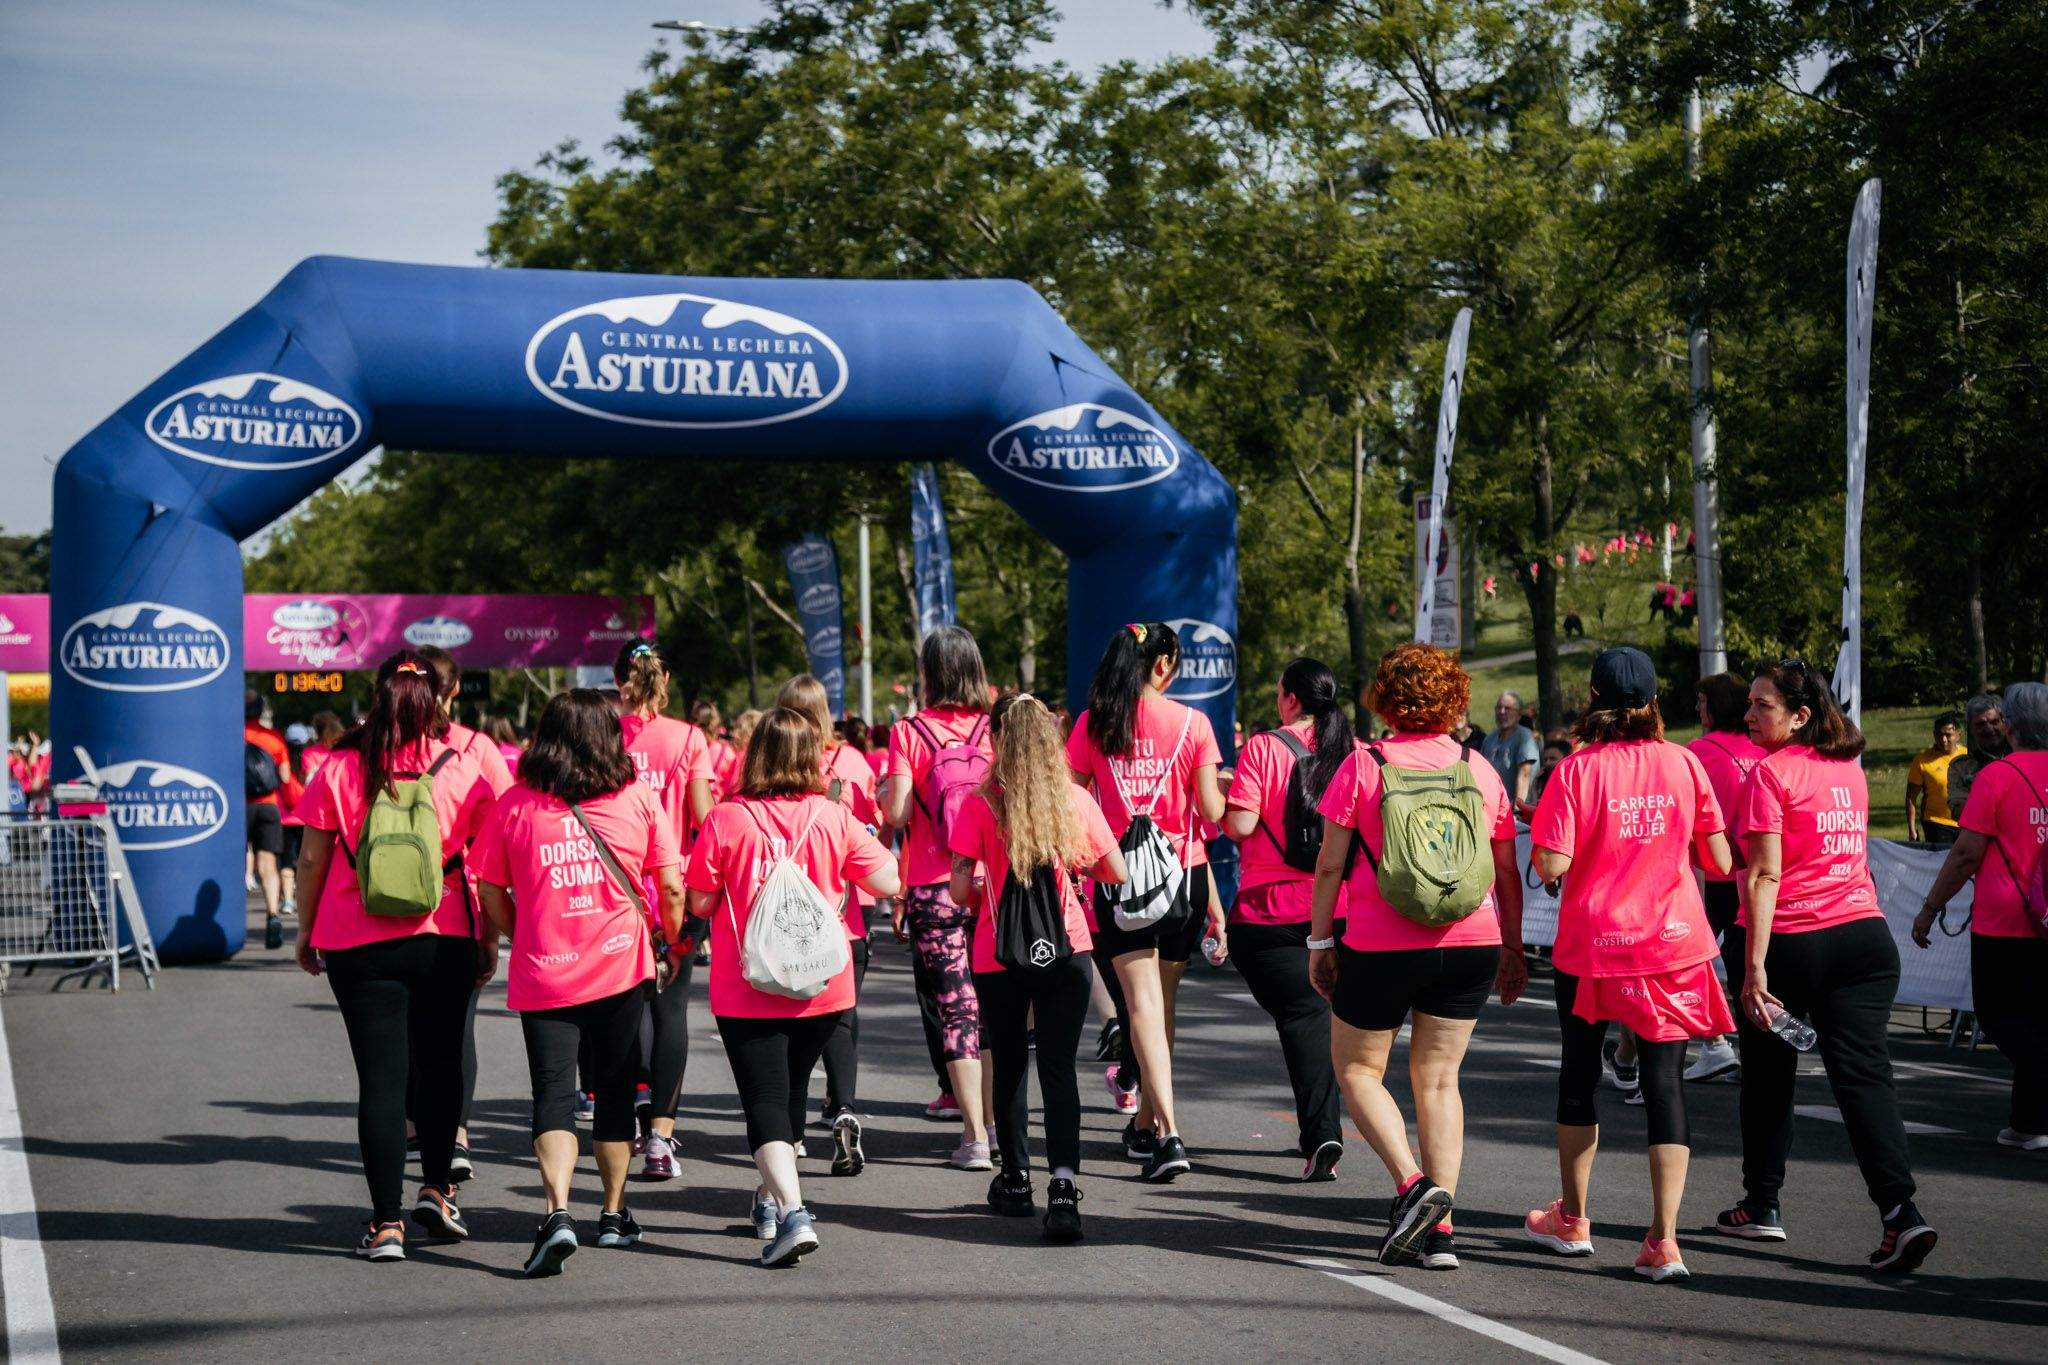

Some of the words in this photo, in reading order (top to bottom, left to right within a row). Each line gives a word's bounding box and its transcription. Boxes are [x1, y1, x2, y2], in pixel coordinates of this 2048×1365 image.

[602, 331, 704, 351] CENTRAL
[713, 336, 814, 355] LECHERA
[550, 332, 824, 399] ASTURIANA
[197, 402, 269, 418] CENTRAL
[275, 408, 344, 423] LECHERA
[159, 403, 344, 449] ASTURIANA
[1034, 434, 1098, 446] CENTRAL
[1005, 437, 1170, 470] ASTURIANA
[92, 633, 151, 644] CENTRAL
[504, 627, 560, 641] OYSHO
[70, 634, 220, 670] ASTURIANA
[1175, 657, 1234, 679] RIANA
[1607, 794, 1676, 813] CARRERA
[1830, 786, 1852, 809] TU
[109, 801, 217, 828] URIANA
[1621, 812, 1640, 825] DE
[1645, 811, 1665, 823] LA
[1619, 822, 1666, 839] MUJER
[539, 839, 601, 867] DORSA
[1820, 833, 1863, 855] SUMA
[550, 862, 606, 890] SUMA
[1828, 863, 1852, 876] 2024
[568, 895, 593, 910] 2024
[1593, 935, 1635, 947] OYSHO
[540, 951, 580, 966] OYSHO
[781, 961, 800, 973] SAN
